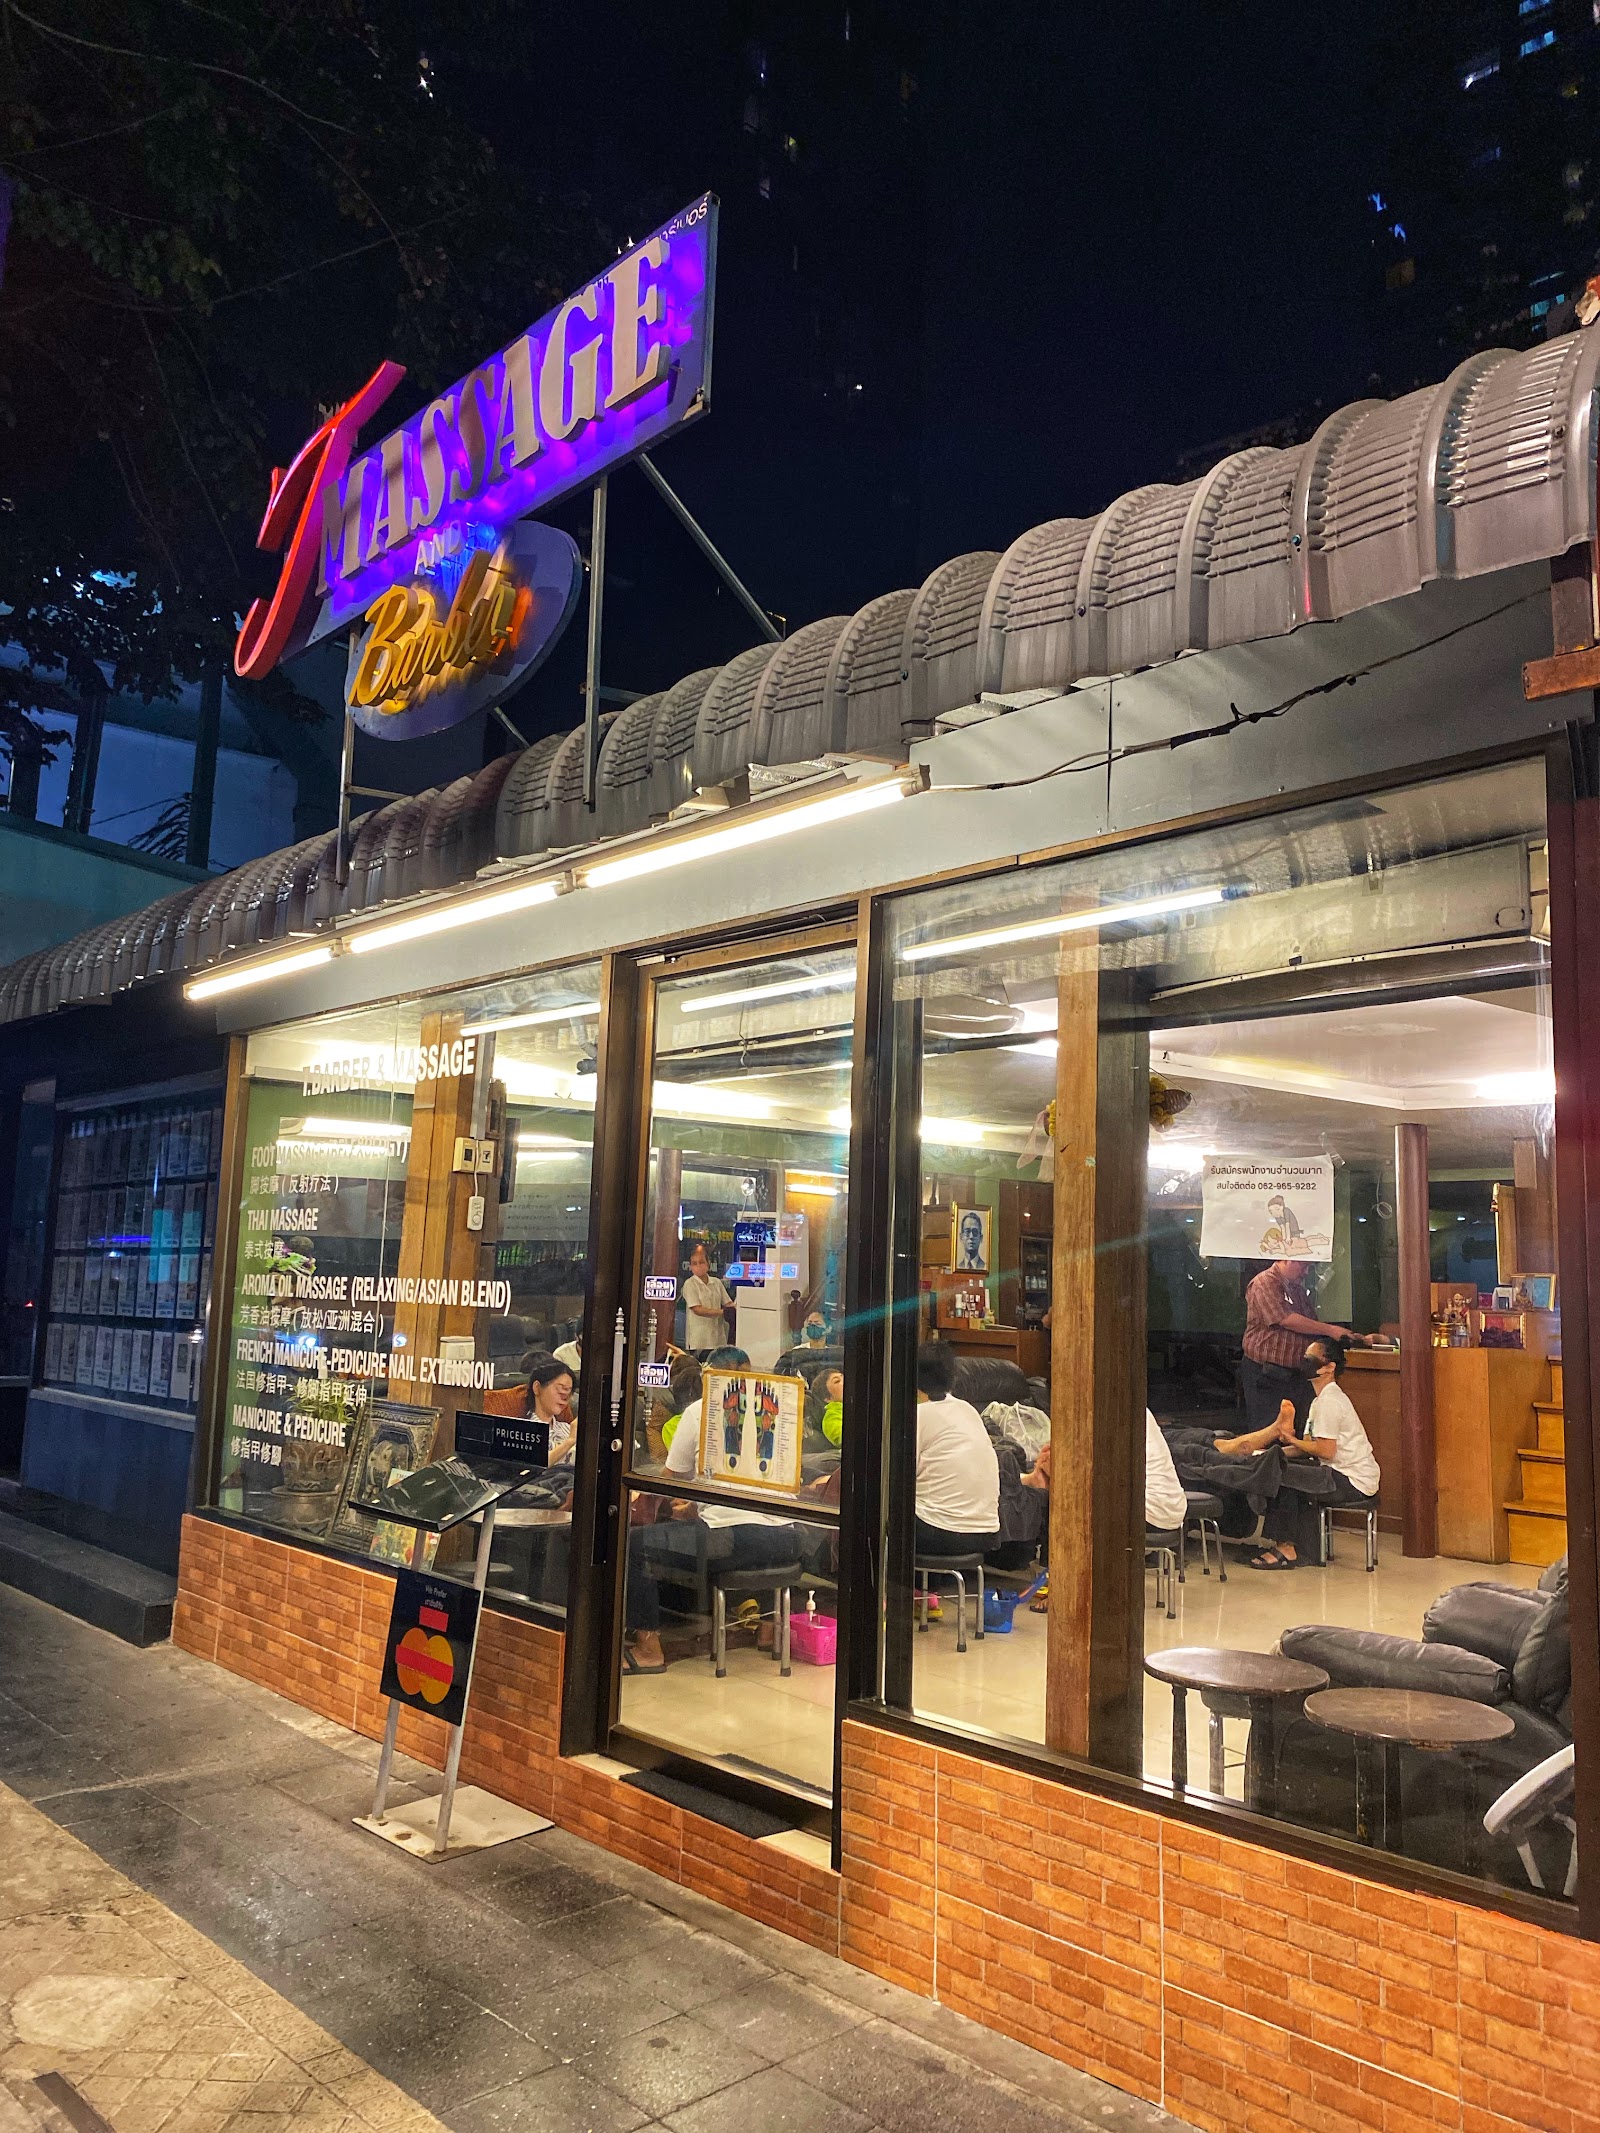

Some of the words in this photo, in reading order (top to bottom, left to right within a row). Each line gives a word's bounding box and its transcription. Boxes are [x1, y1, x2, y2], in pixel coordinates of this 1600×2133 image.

[315, 236, 670, 597] MASSAGE
[414, 520, 464, 576] AND
[348, 548, 518, 707] Barber
[394, 1038, 476, 1083] MASSAGE
[251, 1146, 277, 1168] FOOT
[1216, 1181, 1256, 1190] สนใจติดต่อ
[248, 1210, 269, 1231] THAI
[270, 1208, 319, 1231] MASSAGE
[244, 1241, 286, 1260] 泰式按摩
[241, 1274, 275, 1296] AROMA
[277, 1276, 294, 1297] OIL
[295, 1276, 348, 1301] MASSAGE
[351, 1276, 458, 1307] (RELAXING/ASIAN
[460, 1280, 512, 1316] BLEND)
[646, 1289, 670, 1298] SLIDE
[236, 1338, 273, 1365] FRENCH
[274, 1344, 386, 1378] MANICURE-PEDICURE
[388, 1356, 417, 1383] NAIL
[419, 1359, 495, 1390] EXTENSION
[640, 1375, 664, 1385] SLIDE
[232, 1404, 283, 1435] MANICURE
[283, 1413, 292, 1437] &
[293, 1415, 347, 1448] PEDICURE
[496, 1428, 541, 1444] PRICELESS
[502, 1441, 533, 1451] BANGKOK
